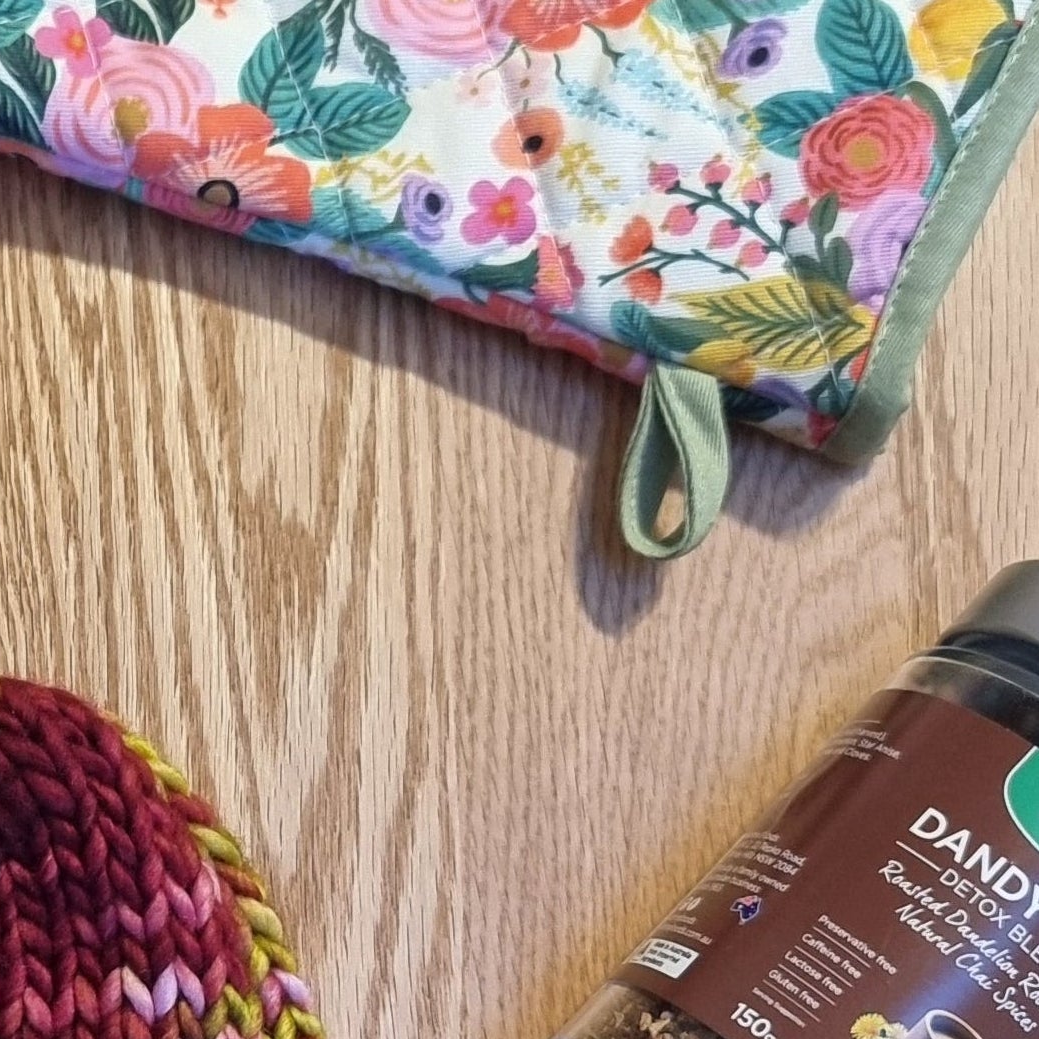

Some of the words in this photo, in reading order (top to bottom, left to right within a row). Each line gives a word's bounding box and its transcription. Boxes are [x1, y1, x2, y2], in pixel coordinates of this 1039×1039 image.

[878, 859, 944, 916] Roasted
[944, 909, 1019, 980] Dandelion
[939, 868, 1011, 929] DETOX
[784, 951, 822, 981] Lactose
[821, 976, 843, 996] free
[802, 933, 841, 964] Caffeine
[840, 959, 862, 979] free
[818, 914, 876, 959] Preservative
[875, 955, 898, 976] free
[894, 903, 964, 956] Natural
[955, 953, 998, 991] Chai
[993, 986, 1038, 1033] Spices
[768, 969, 800, 995] Gluten
[799, 990, 820, 1010] free
